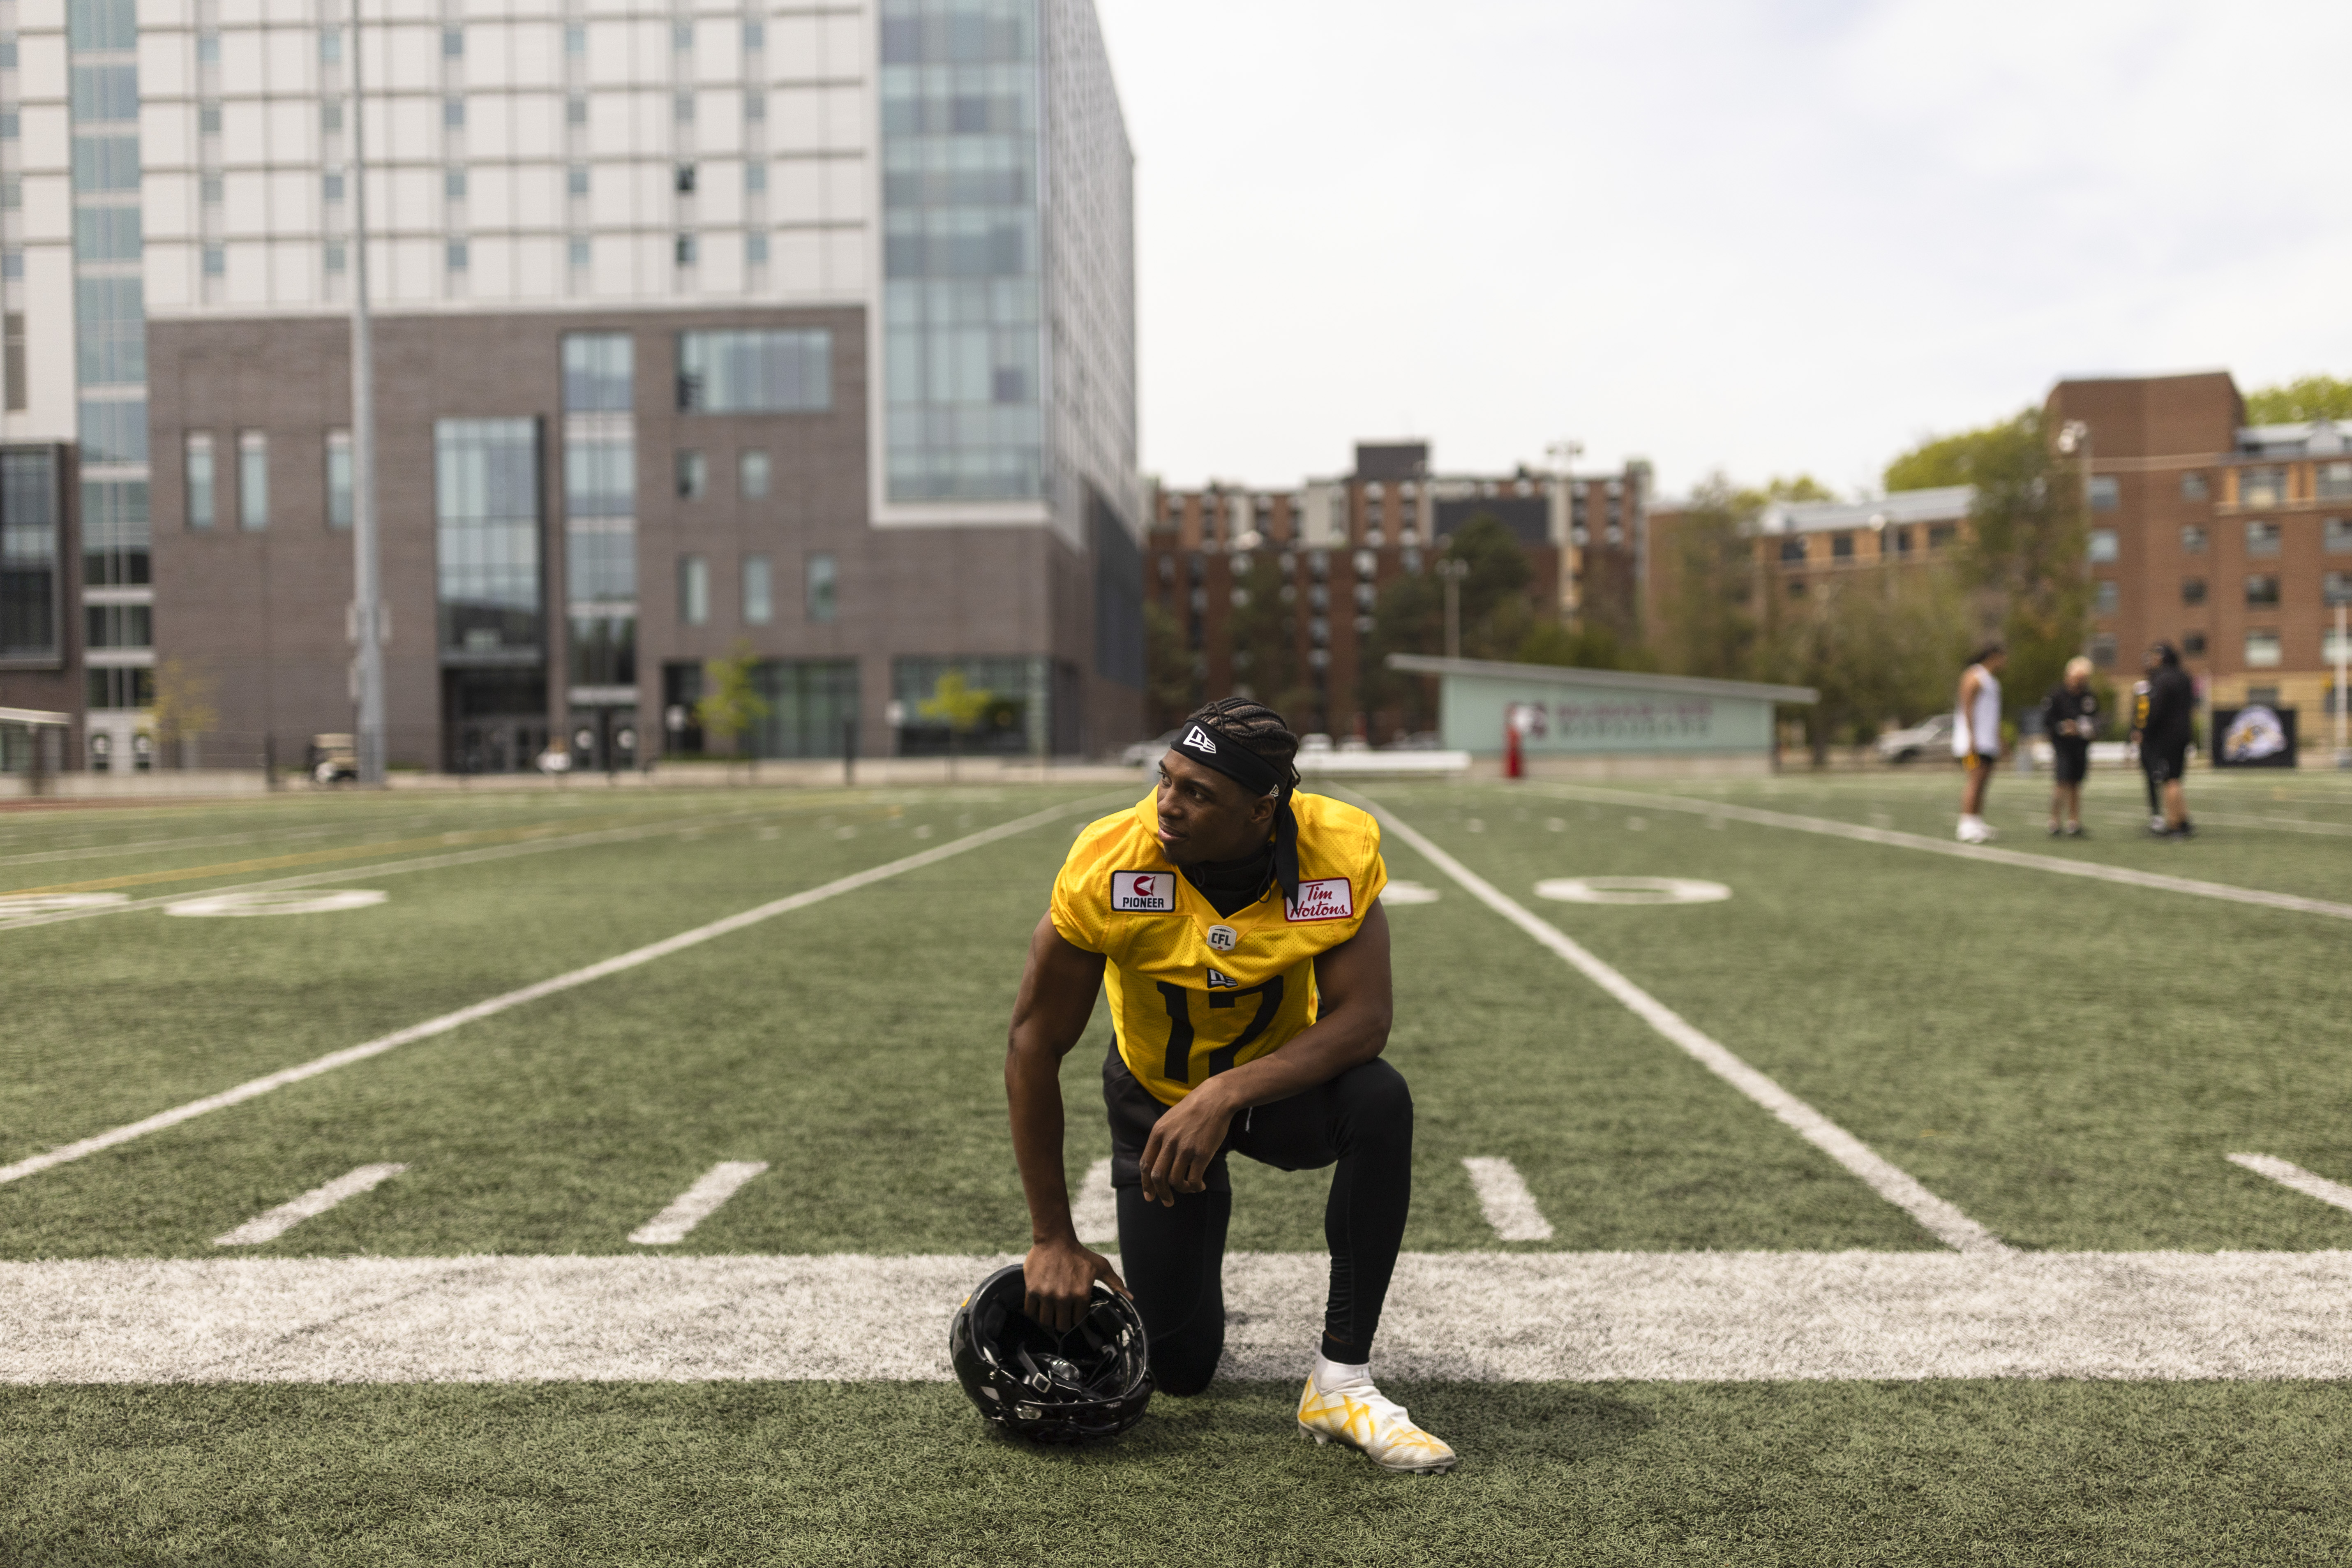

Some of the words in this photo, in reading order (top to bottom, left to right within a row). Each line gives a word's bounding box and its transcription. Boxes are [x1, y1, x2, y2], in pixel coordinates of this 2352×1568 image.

[1306, 882, 1333, 901] Tim
[1122, 897, 1164, 908] PIONEER
[1211, 932, 1231, 946] CFL
